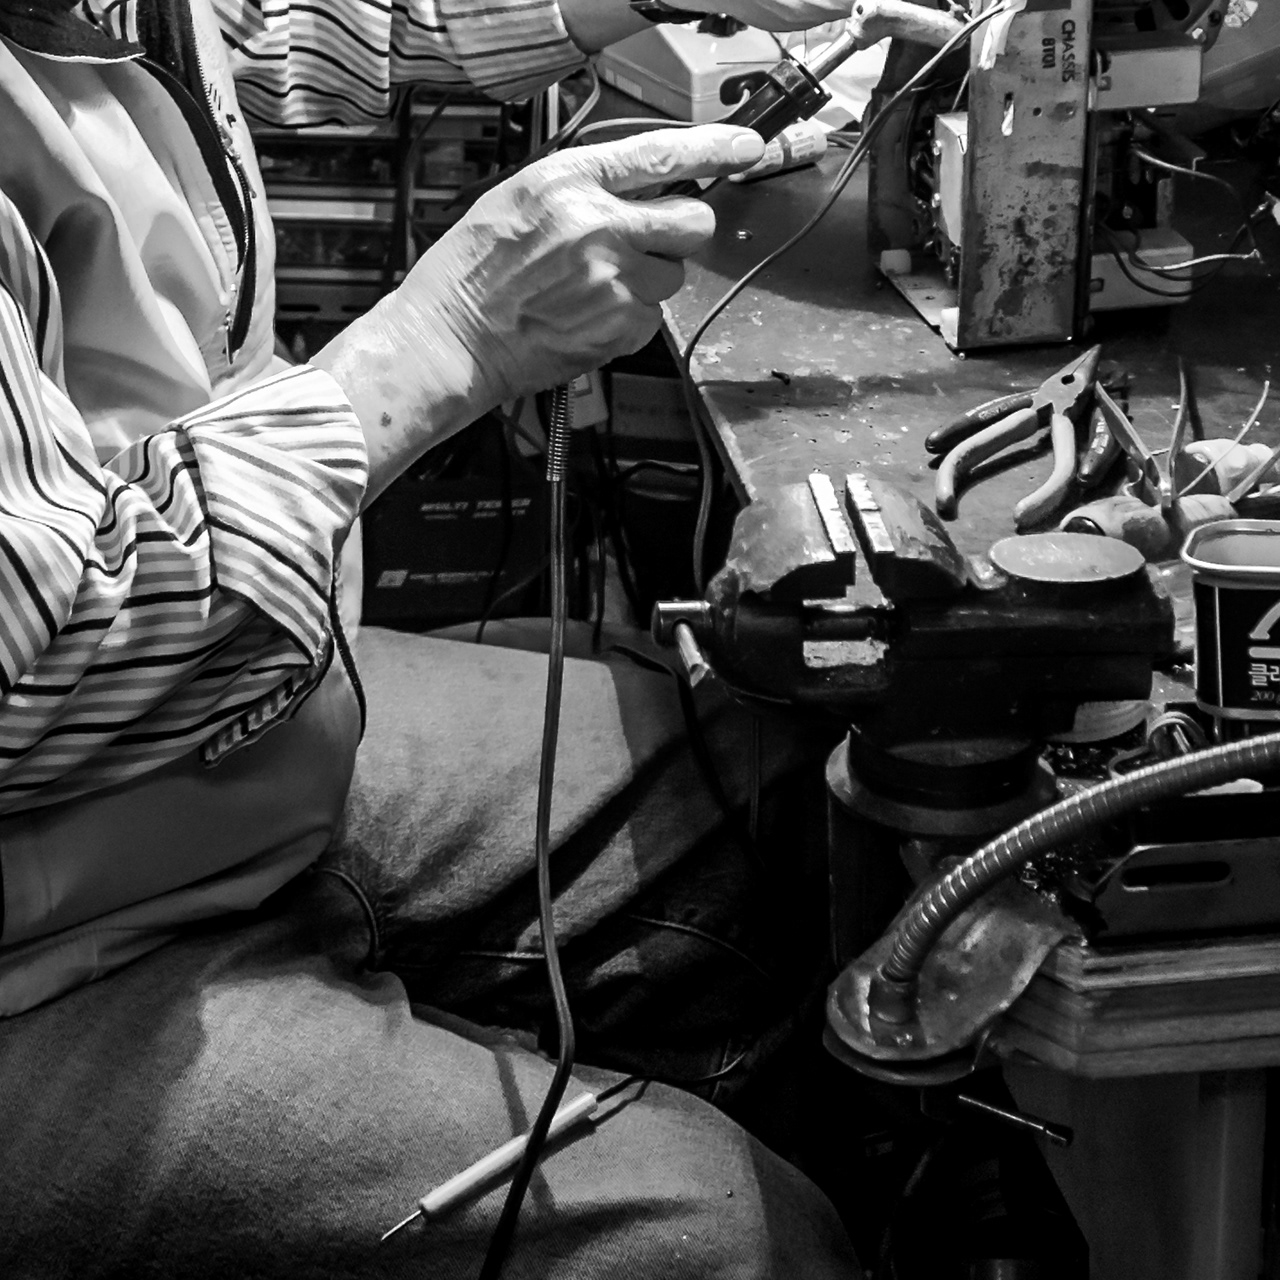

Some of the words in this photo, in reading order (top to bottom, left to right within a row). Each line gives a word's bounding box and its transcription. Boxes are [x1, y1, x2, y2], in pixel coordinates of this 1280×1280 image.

[1062, 19, 1076, 82] CHASSIS
[475, 497, 532, 510] TESER
[1250, 690, 1275, 702] 200
